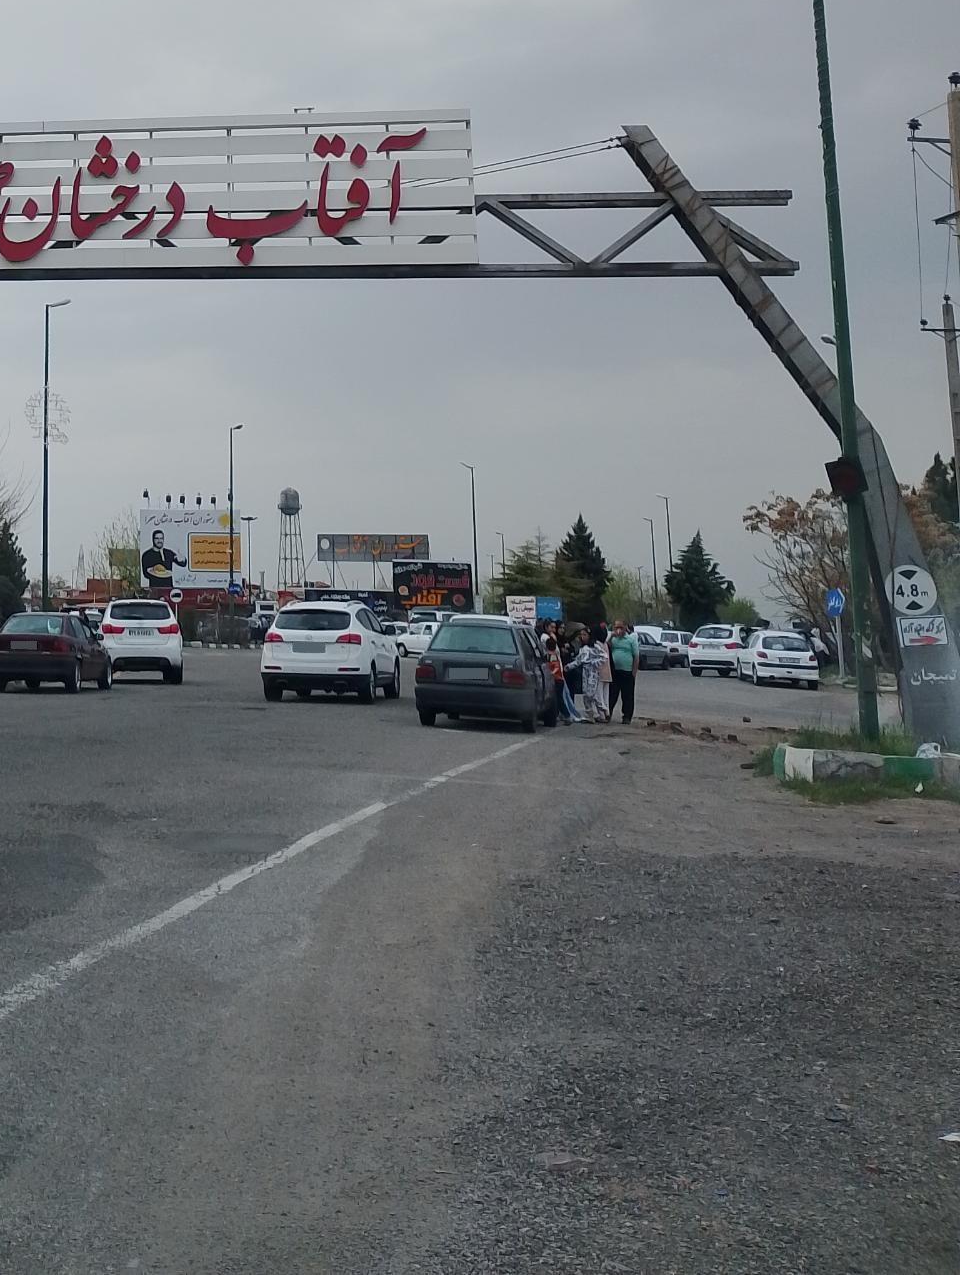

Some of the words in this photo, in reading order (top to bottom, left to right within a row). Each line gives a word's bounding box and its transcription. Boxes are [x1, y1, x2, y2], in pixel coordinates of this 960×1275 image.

[207, 127, 427, 265] آفتاب
[410, 569, 435, 588] فود
[436, 570, 470, 588] فست
[400, 589, 449, 609] آفتاب
